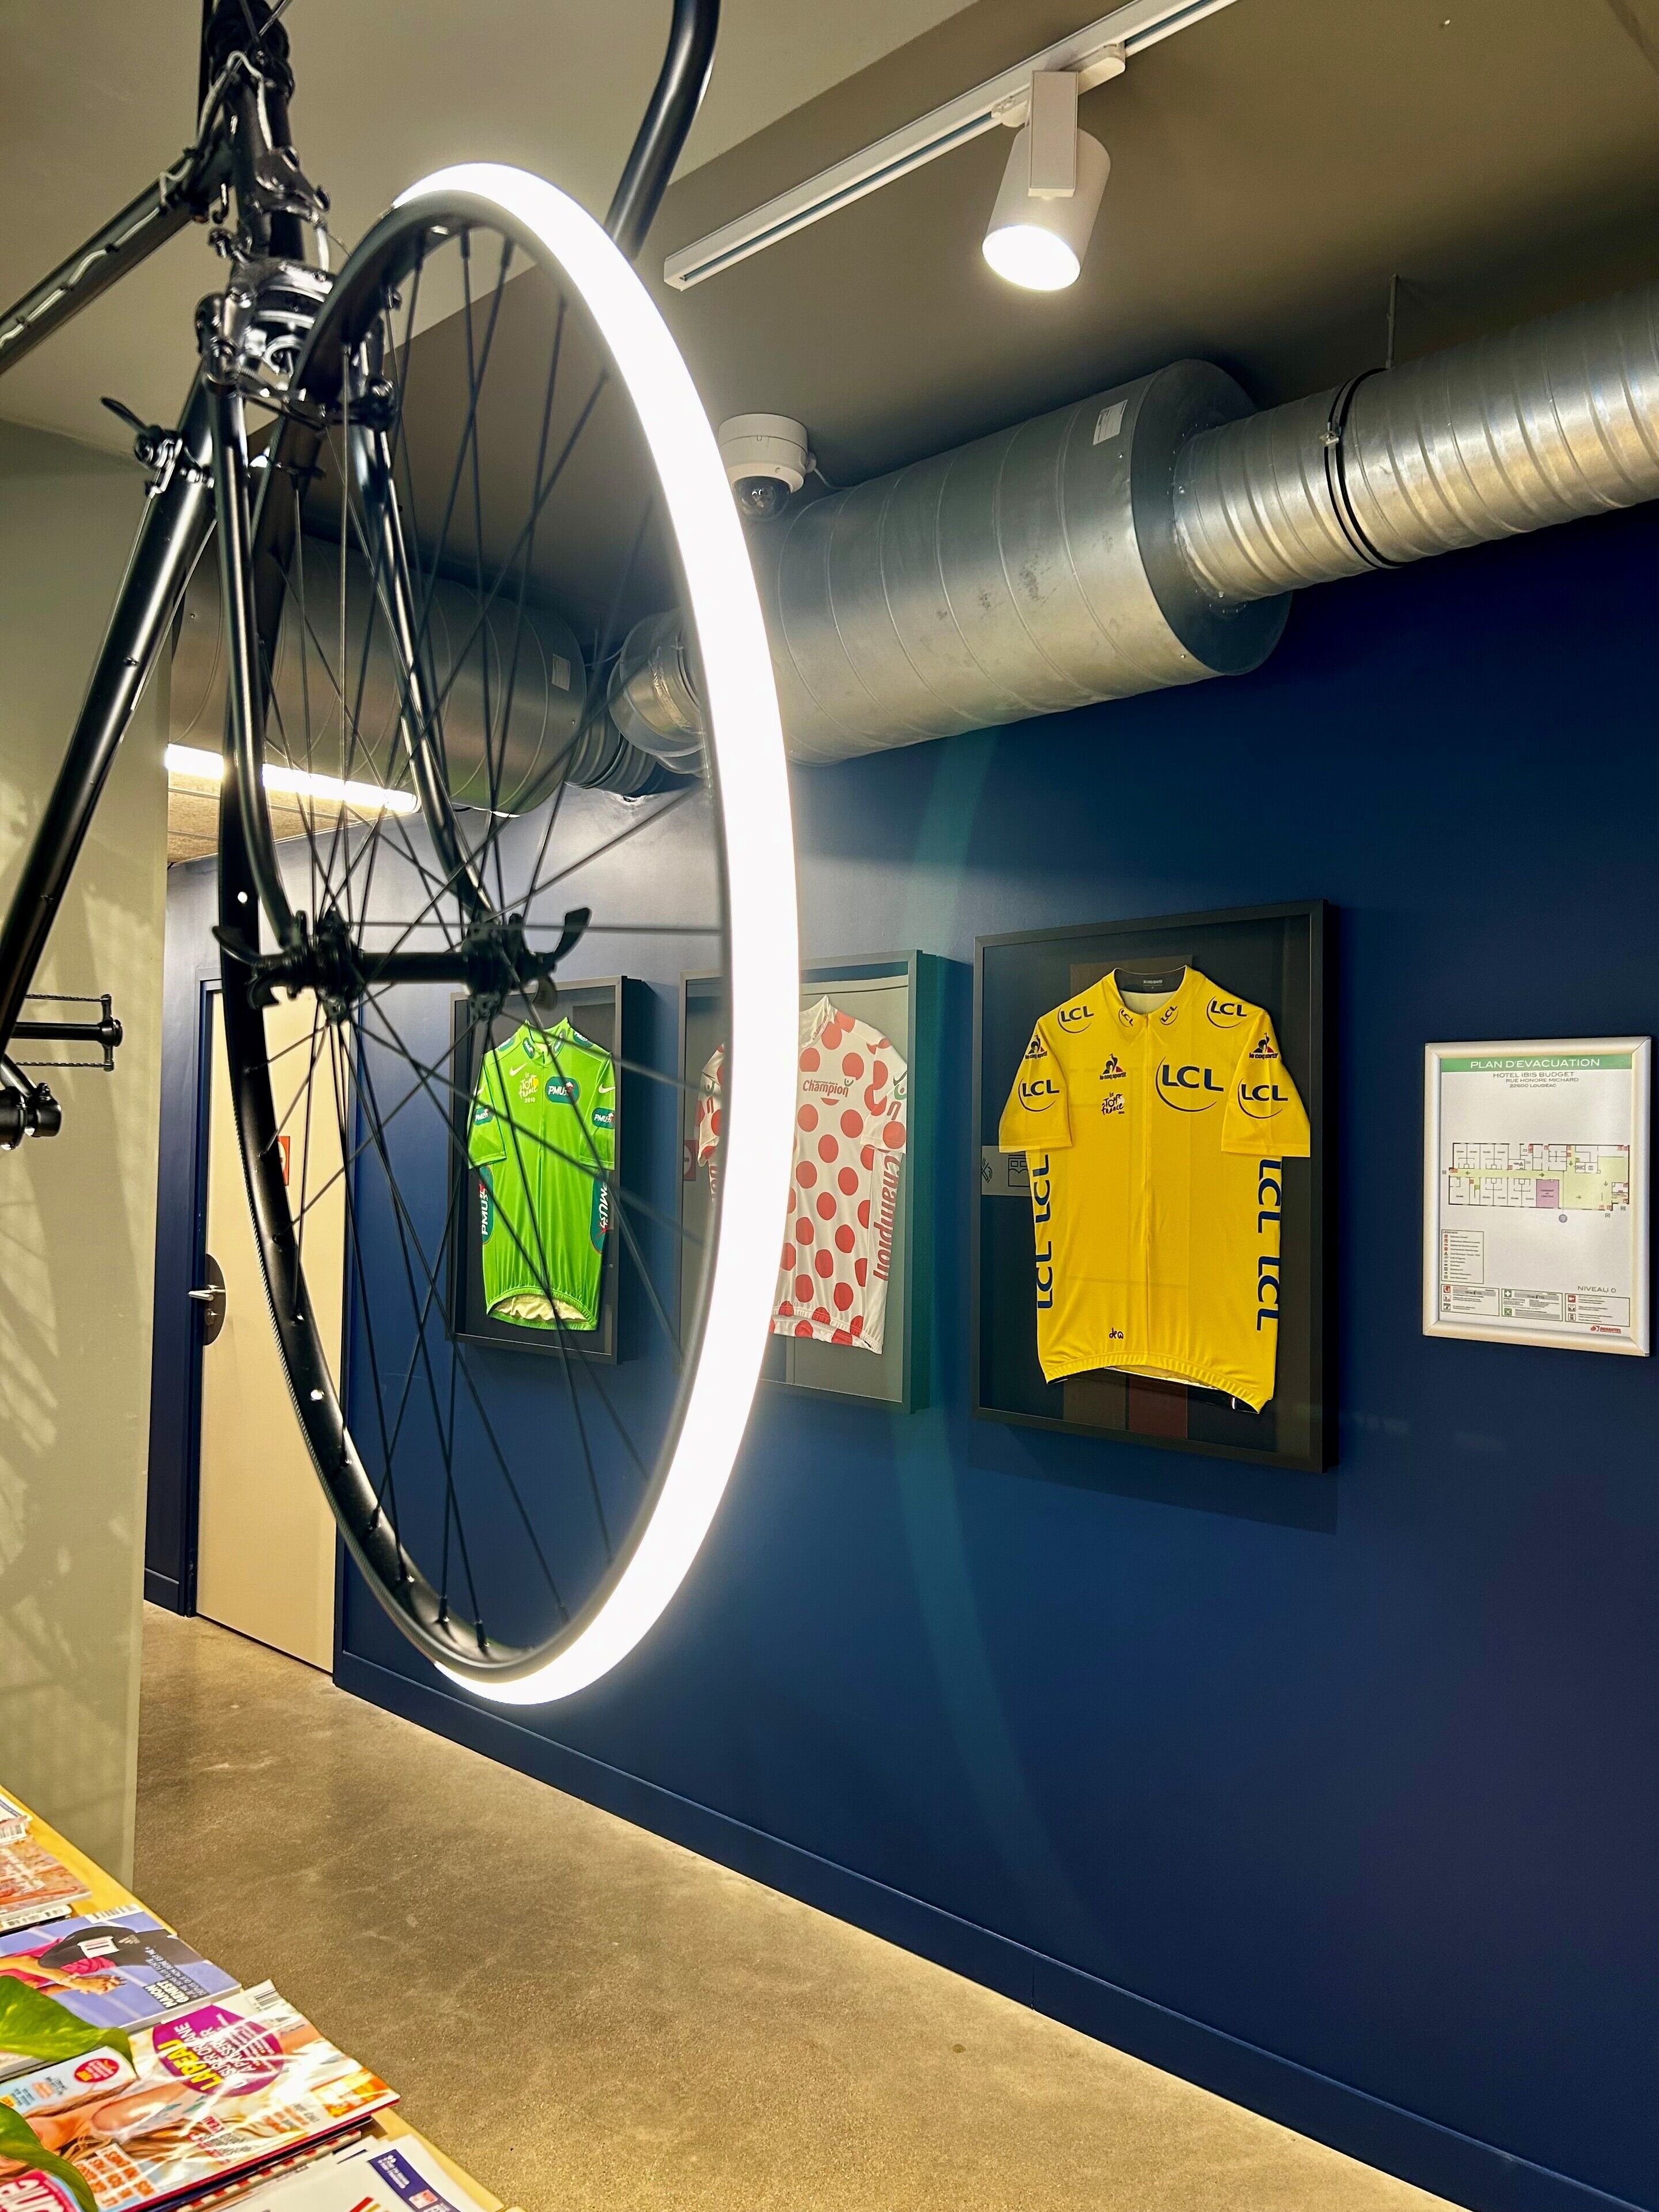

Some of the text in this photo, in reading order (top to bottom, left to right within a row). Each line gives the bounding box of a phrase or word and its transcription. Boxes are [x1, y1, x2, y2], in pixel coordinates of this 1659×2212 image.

[1060, 1006, 1094, 1022] LCL
[1120, 1009, 1134, 1027] LCL
[1160, 1005, 1177, 1022] LCL
[1210, 1001, 1247, 1017] LCL
[1470, 1059, 1600, 1069] PLAN D'EVACUATION
[802, 1079, 849, 1097] Champion
[1022, 1079, 1060, 1097] LCL
[1161, 1064, 1224, 1092] LCL
[548, 1085, 566, 1095] PMU
[1241, 1084, 1289, 1101] LCL
[1032, 1154, 1051, 1224] LCL
[1258, 1159, 1282, 1234] LCL
[1035, 1240, 1054, 1309] LCL
[1256, 1256, 1281, 1331] LCL
[145, 1984, 177, 2008] MANON
[156, 1979, 191, 2003] GENEST
[158, 2037, 207, 2077] PEAU
[190, 2068, 224, 2091] LA
